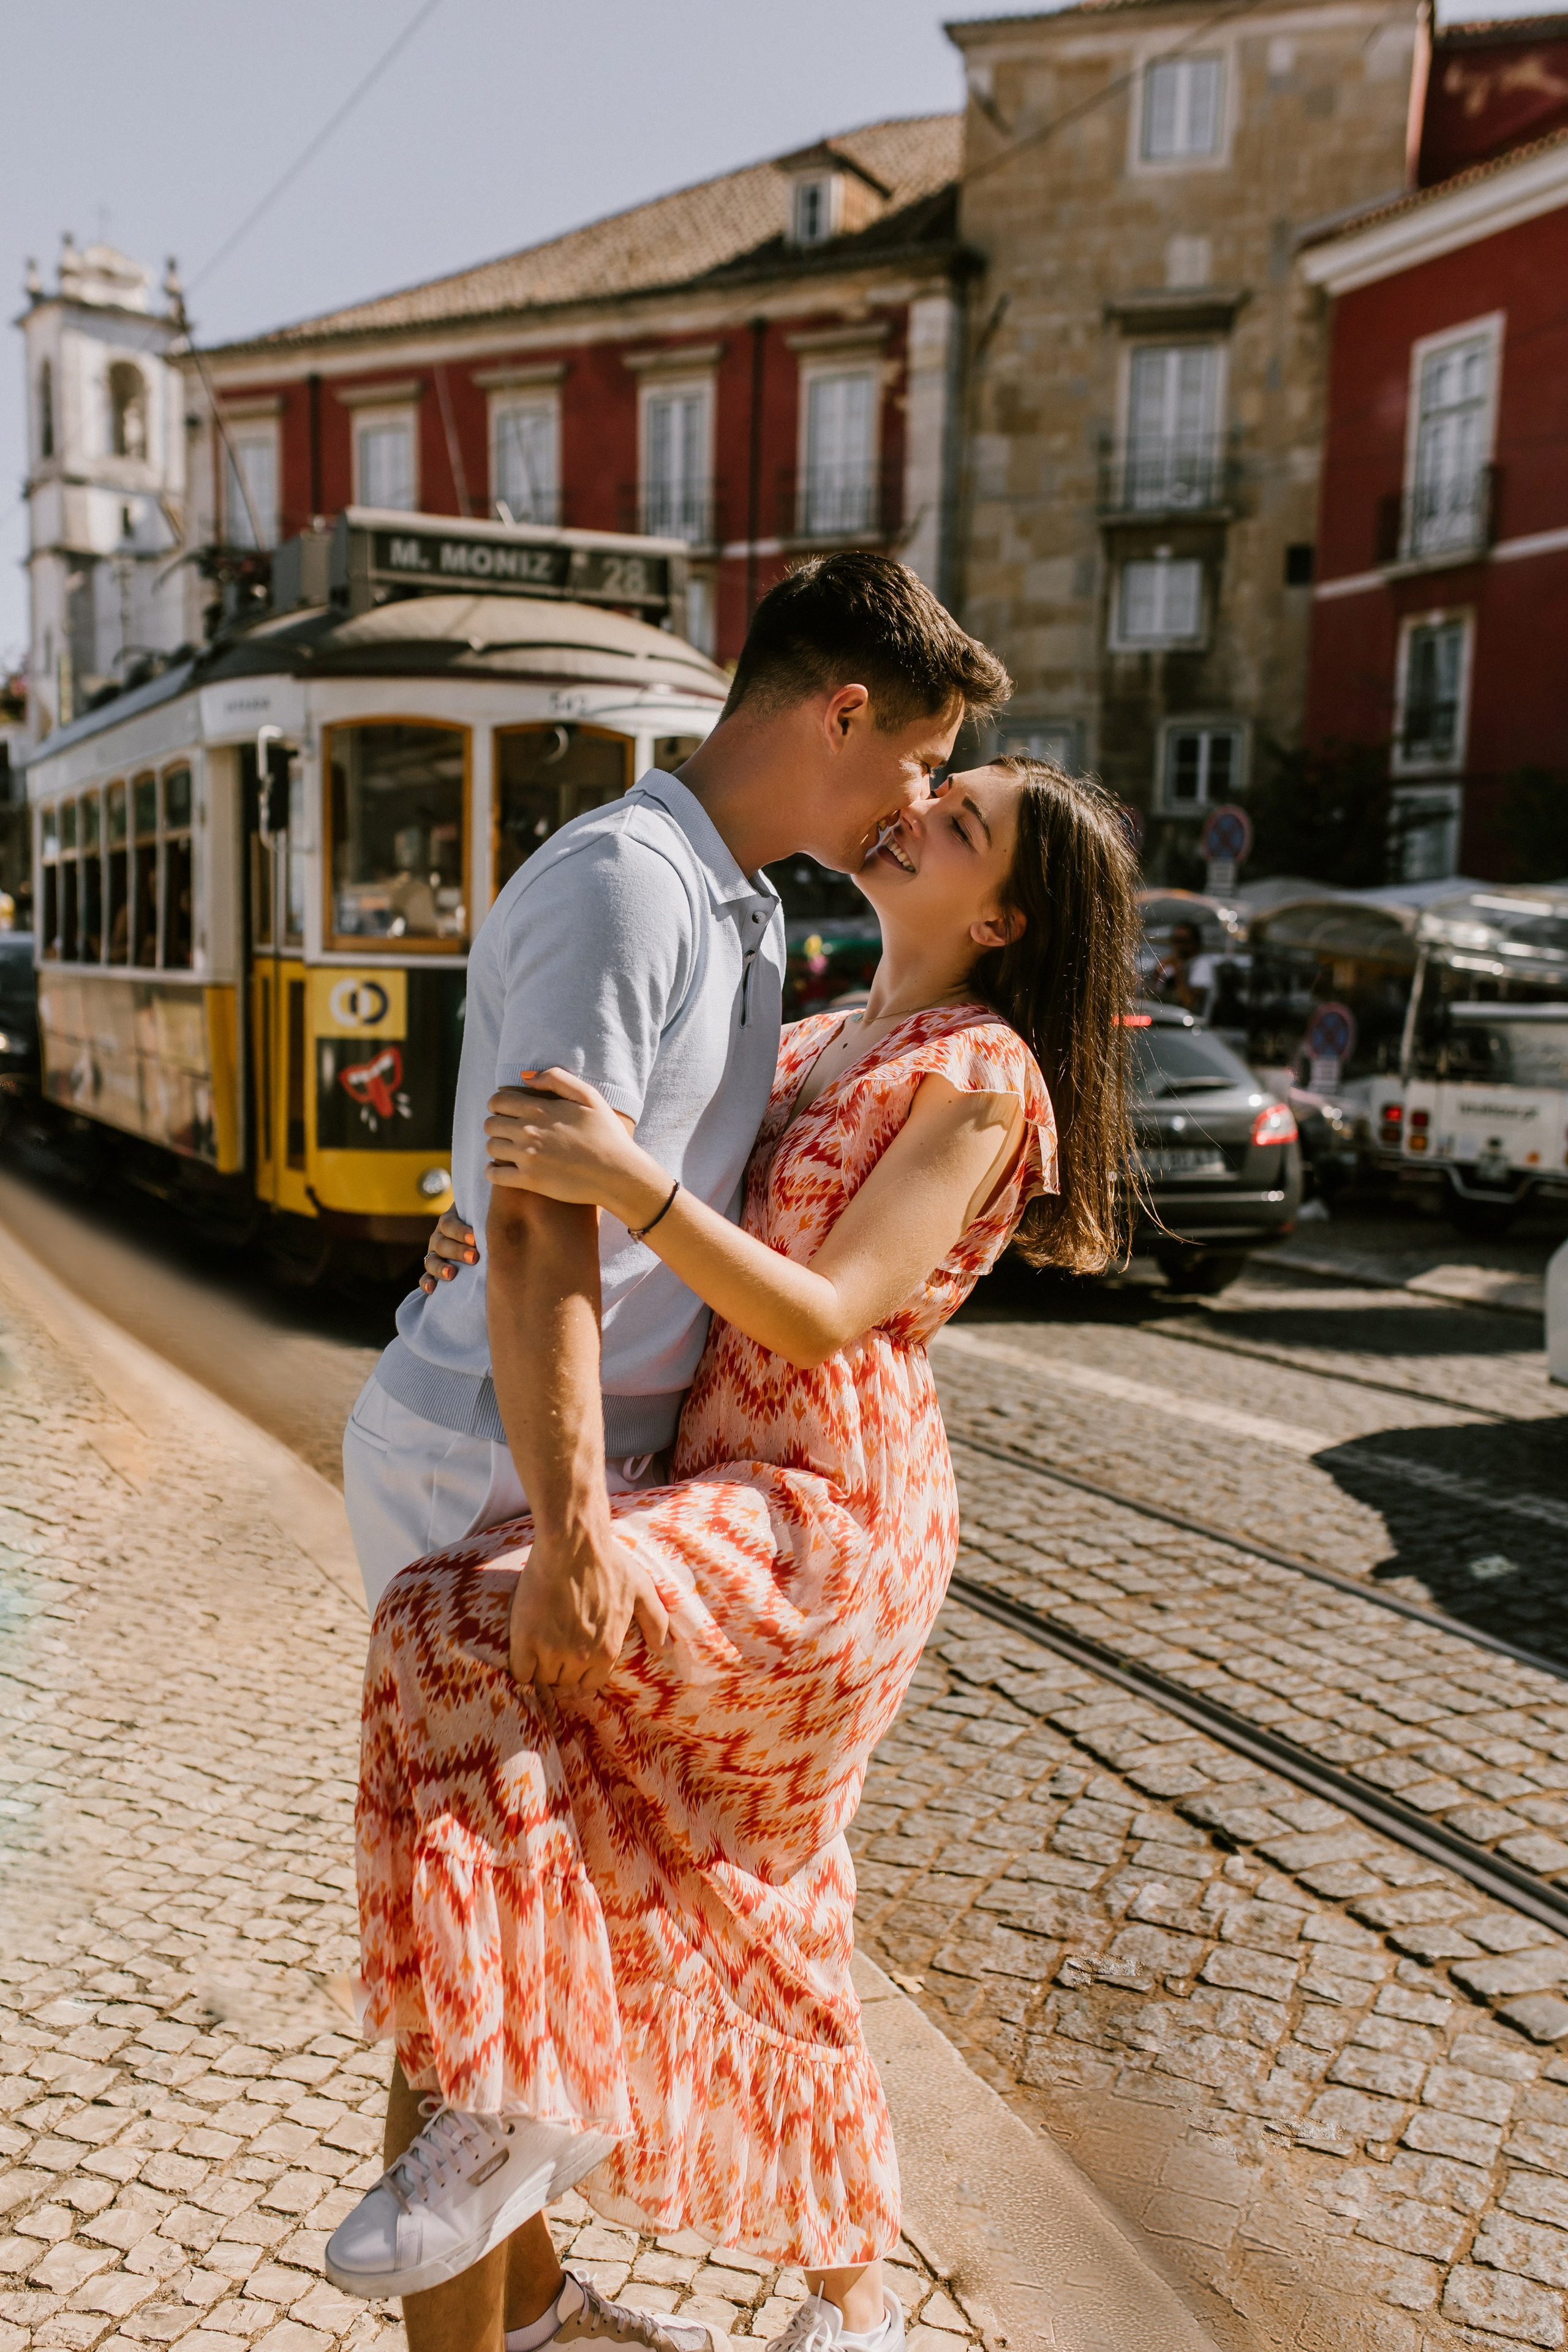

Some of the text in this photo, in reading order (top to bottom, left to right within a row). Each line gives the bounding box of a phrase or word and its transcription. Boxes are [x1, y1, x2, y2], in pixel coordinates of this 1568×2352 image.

[390, 537, 551, 580] M. MONIZ
[602, 557, 647, 595] 28
